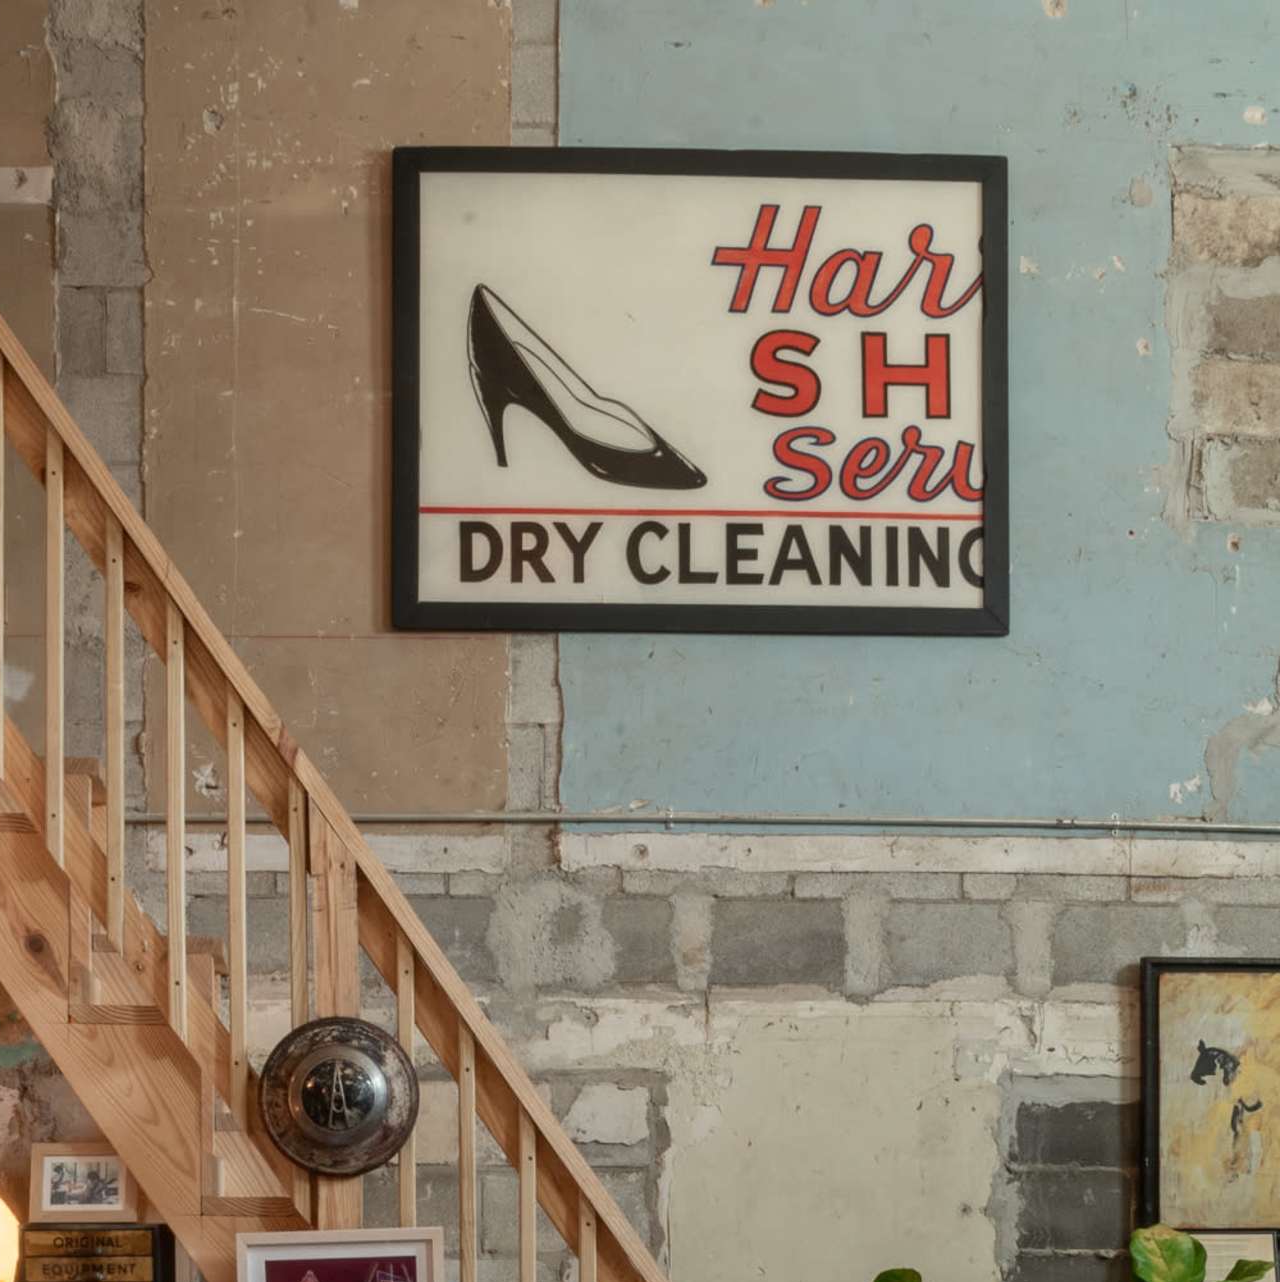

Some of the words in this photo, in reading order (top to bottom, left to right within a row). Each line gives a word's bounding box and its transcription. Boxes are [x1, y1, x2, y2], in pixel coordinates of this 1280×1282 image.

[711, 204, 984, 318] Har
[750, 329, 952, 419] SH
[458, 520, 605, 585] DRY
[42, 1263, 137, 1276] EQUIPMENT
[52, 1236, 124, 1250] ORIGINAL
